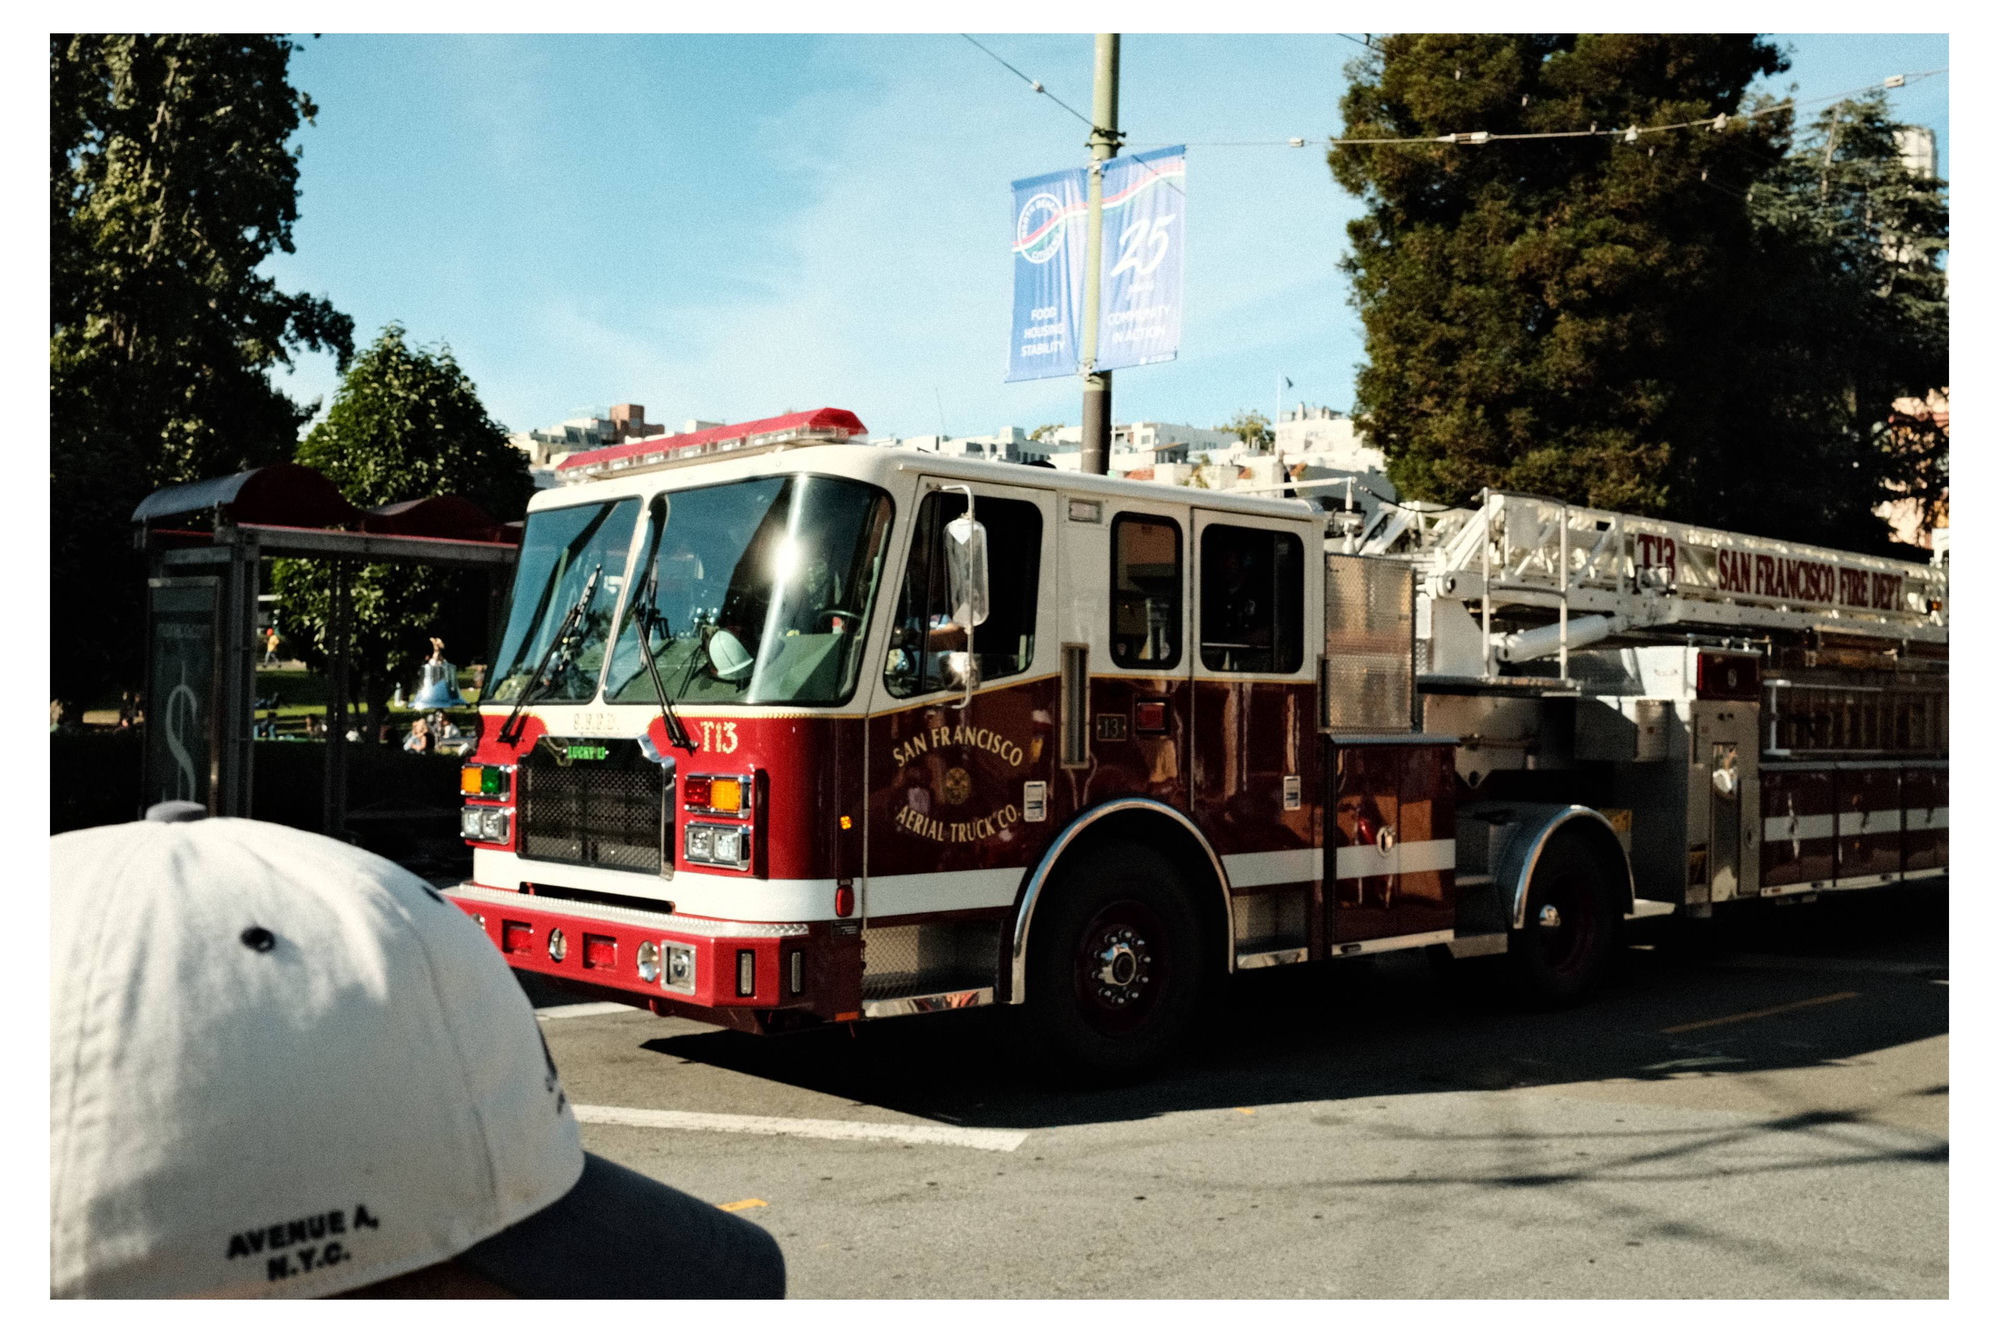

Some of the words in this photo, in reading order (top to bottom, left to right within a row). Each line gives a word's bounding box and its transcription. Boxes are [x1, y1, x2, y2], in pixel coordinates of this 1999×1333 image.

[1110, 213, 1176, 277] 25
[1023, 322, 1064, 339] HOUSING
[1031, 306, 1057, 320] FOOD
[1020, 340, 1065, 357] STABILITY
[1637, 533, 1676, 582] T13
[1718, 549, 1752, 593] SAN
[1755, 554, 1835, 604] FRANCISCO
[1839, 566, 1869, 608] FIRE
[700, 721, 738, 754] T13
[893, 734, 927, 767] SAN
[931, 725, 1023, 767] FRANCISCO
[1102, 718, 1119, 737] 13
[568, 746, 594, 760] LUCKY
[896, 805, 945, 842] AERIAL
[950, 814, 995, 843] TRUCK
[225, 1210, 346, 1260] AVENUE
[267, 1242, 351, 1282] N.Y.C.
